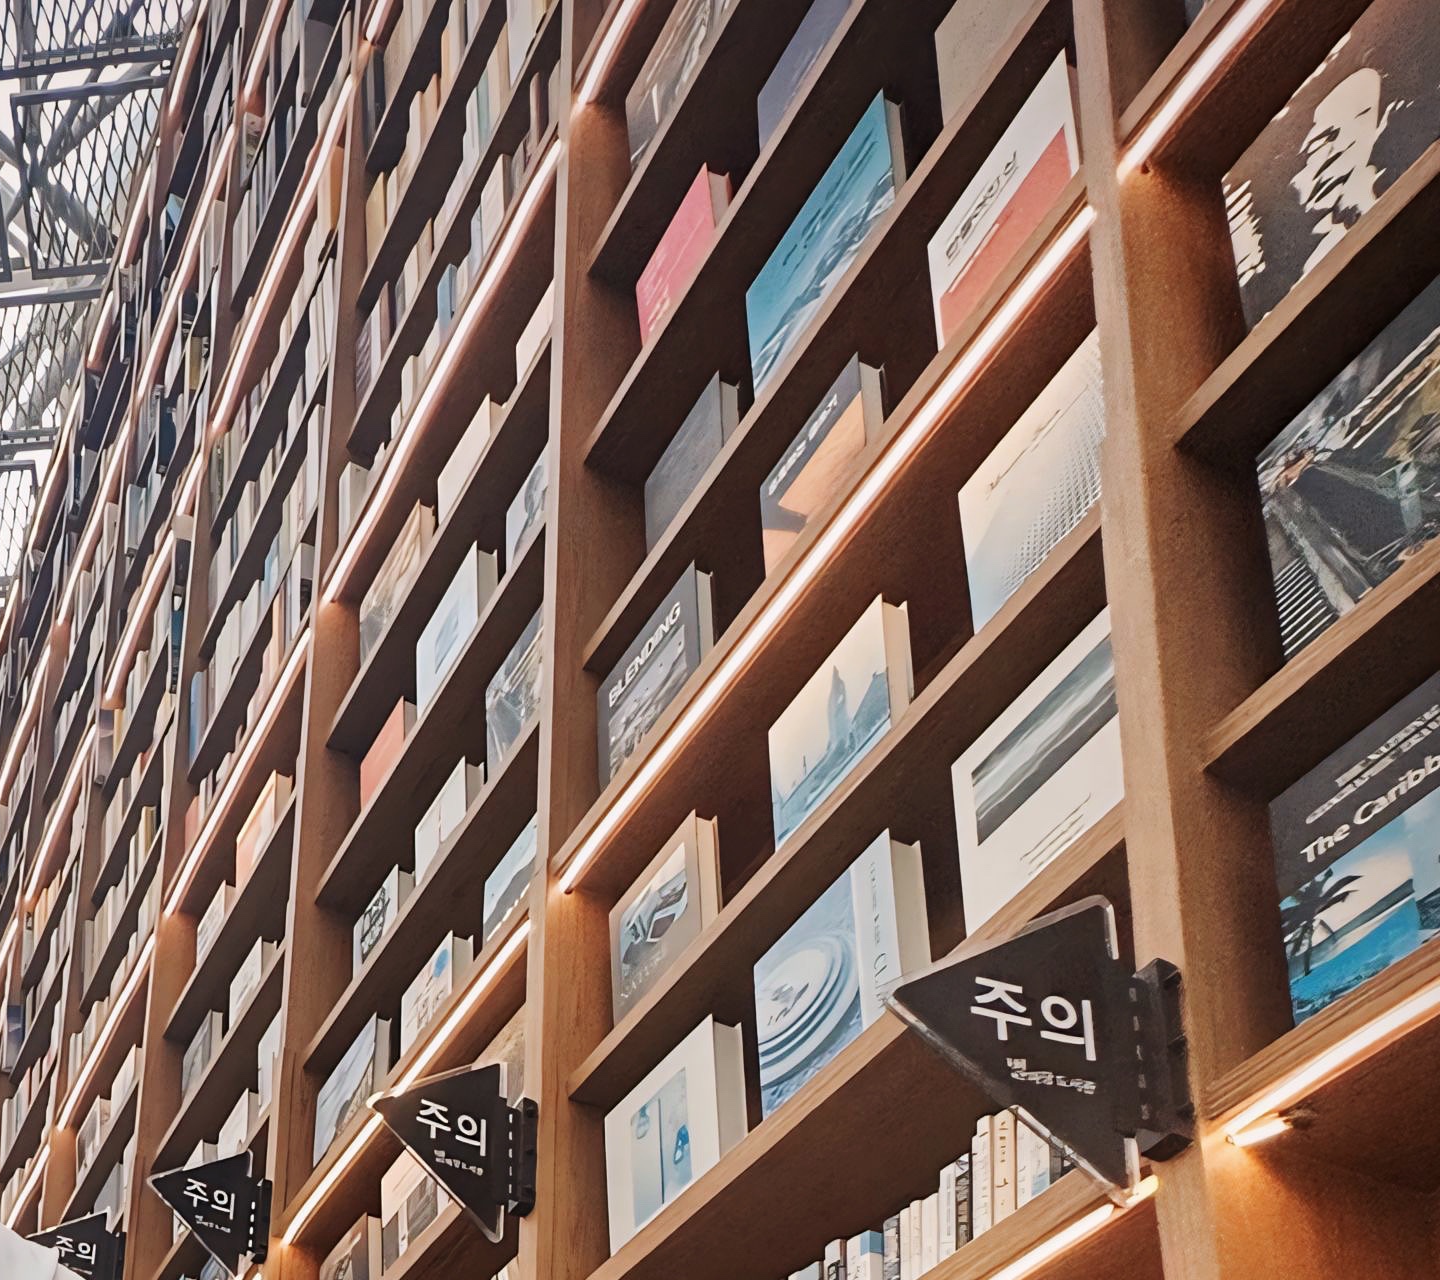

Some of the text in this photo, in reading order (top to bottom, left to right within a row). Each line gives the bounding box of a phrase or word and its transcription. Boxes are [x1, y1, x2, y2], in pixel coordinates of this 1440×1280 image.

[608, 601, 681, 709] BLENDING
[1300, 824, 1351, 863] The
[969, 976, 1097, 1061] 주의
[415, 1098, 487, 1157] 주의
[183, 1178, 236, 1220] 주의
[55, 1235, 97, 1265] 주의
